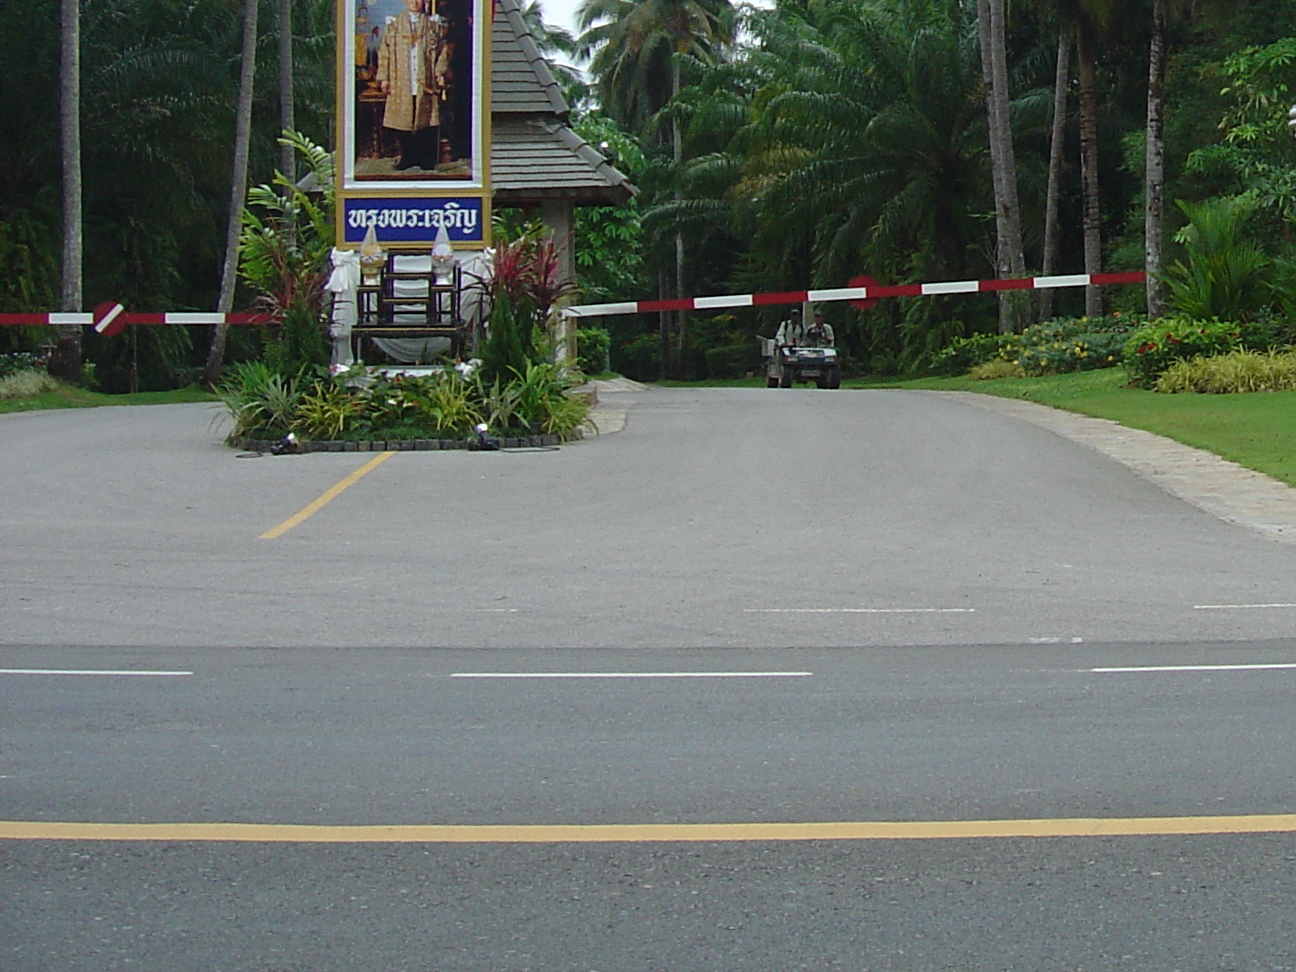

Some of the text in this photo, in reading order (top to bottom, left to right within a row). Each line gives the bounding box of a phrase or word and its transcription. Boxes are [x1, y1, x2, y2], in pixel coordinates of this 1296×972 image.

[348, 202, 477, 234] ทรงพระเจริญ
